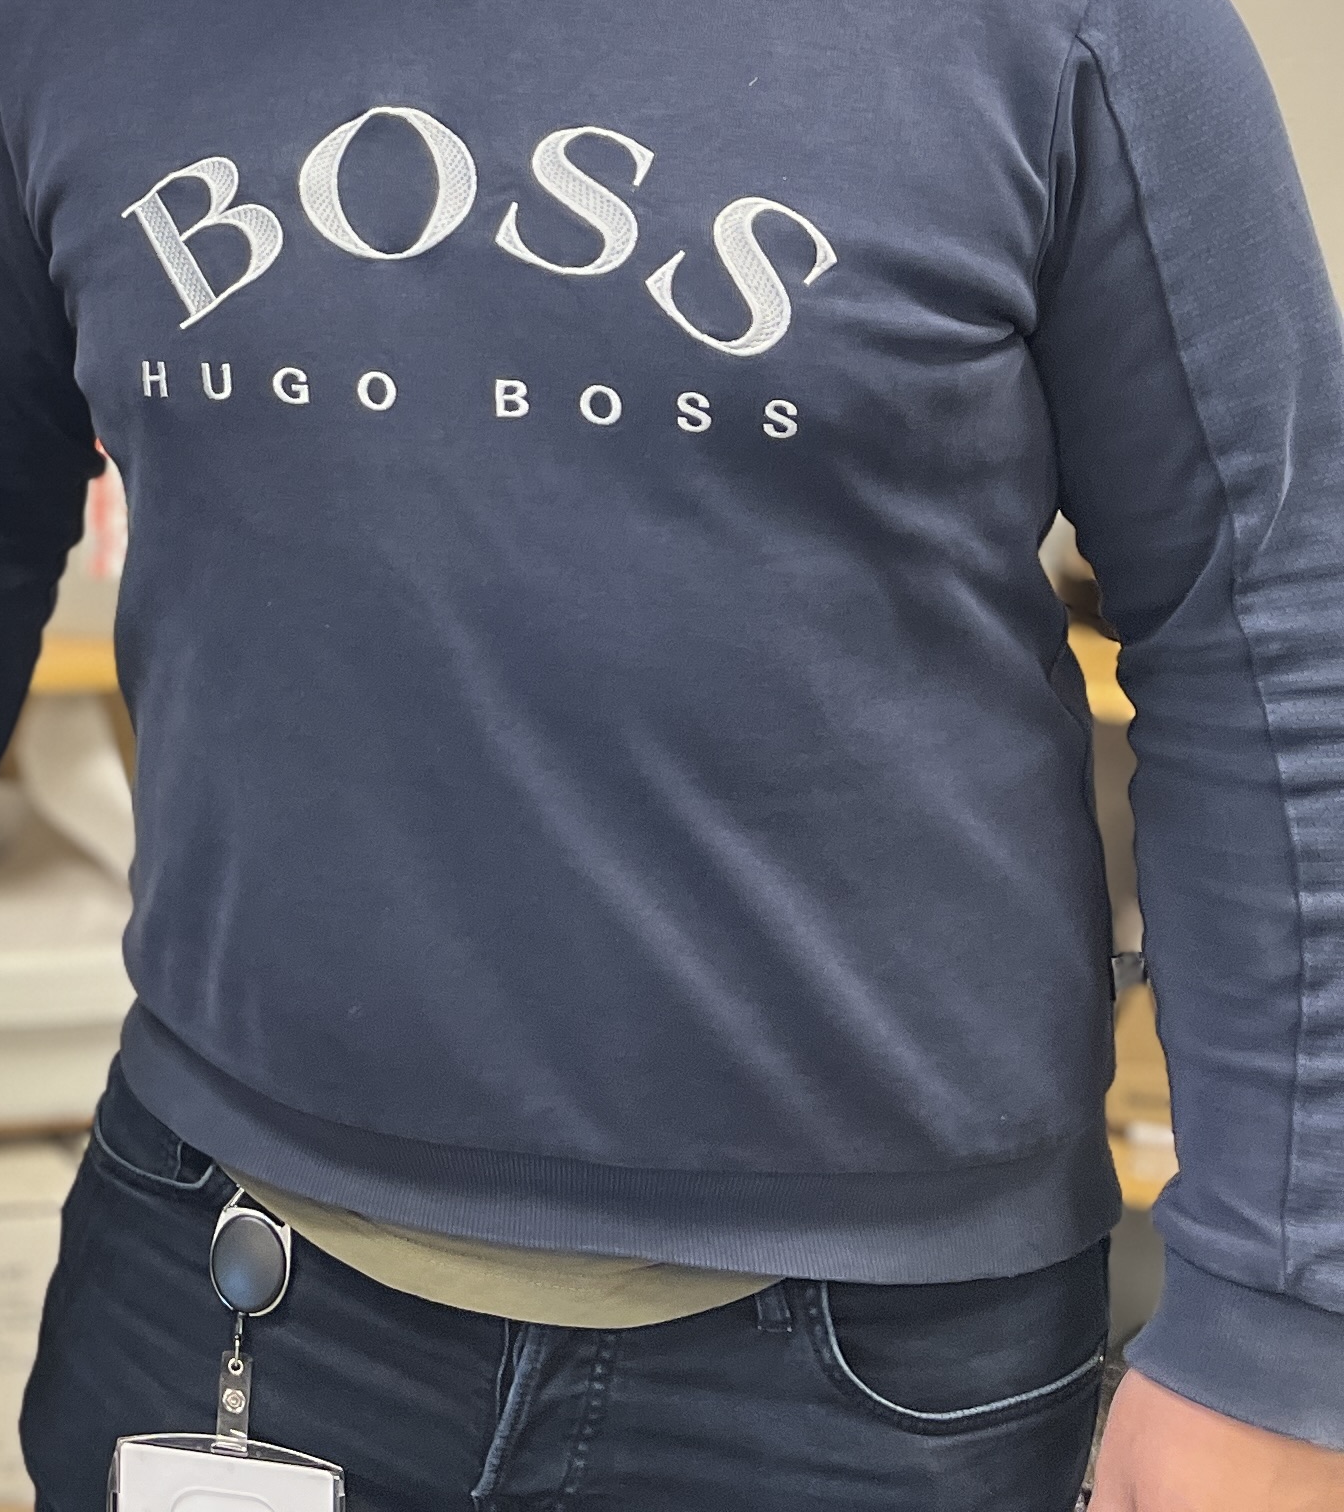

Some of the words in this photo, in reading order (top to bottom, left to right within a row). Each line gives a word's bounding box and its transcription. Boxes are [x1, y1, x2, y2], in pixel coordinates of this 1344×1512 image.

[121, 106, 838, 356] BOSS
[141, 359, 398, 412] HUGO
[495, 378, 799, 439] BOSS
